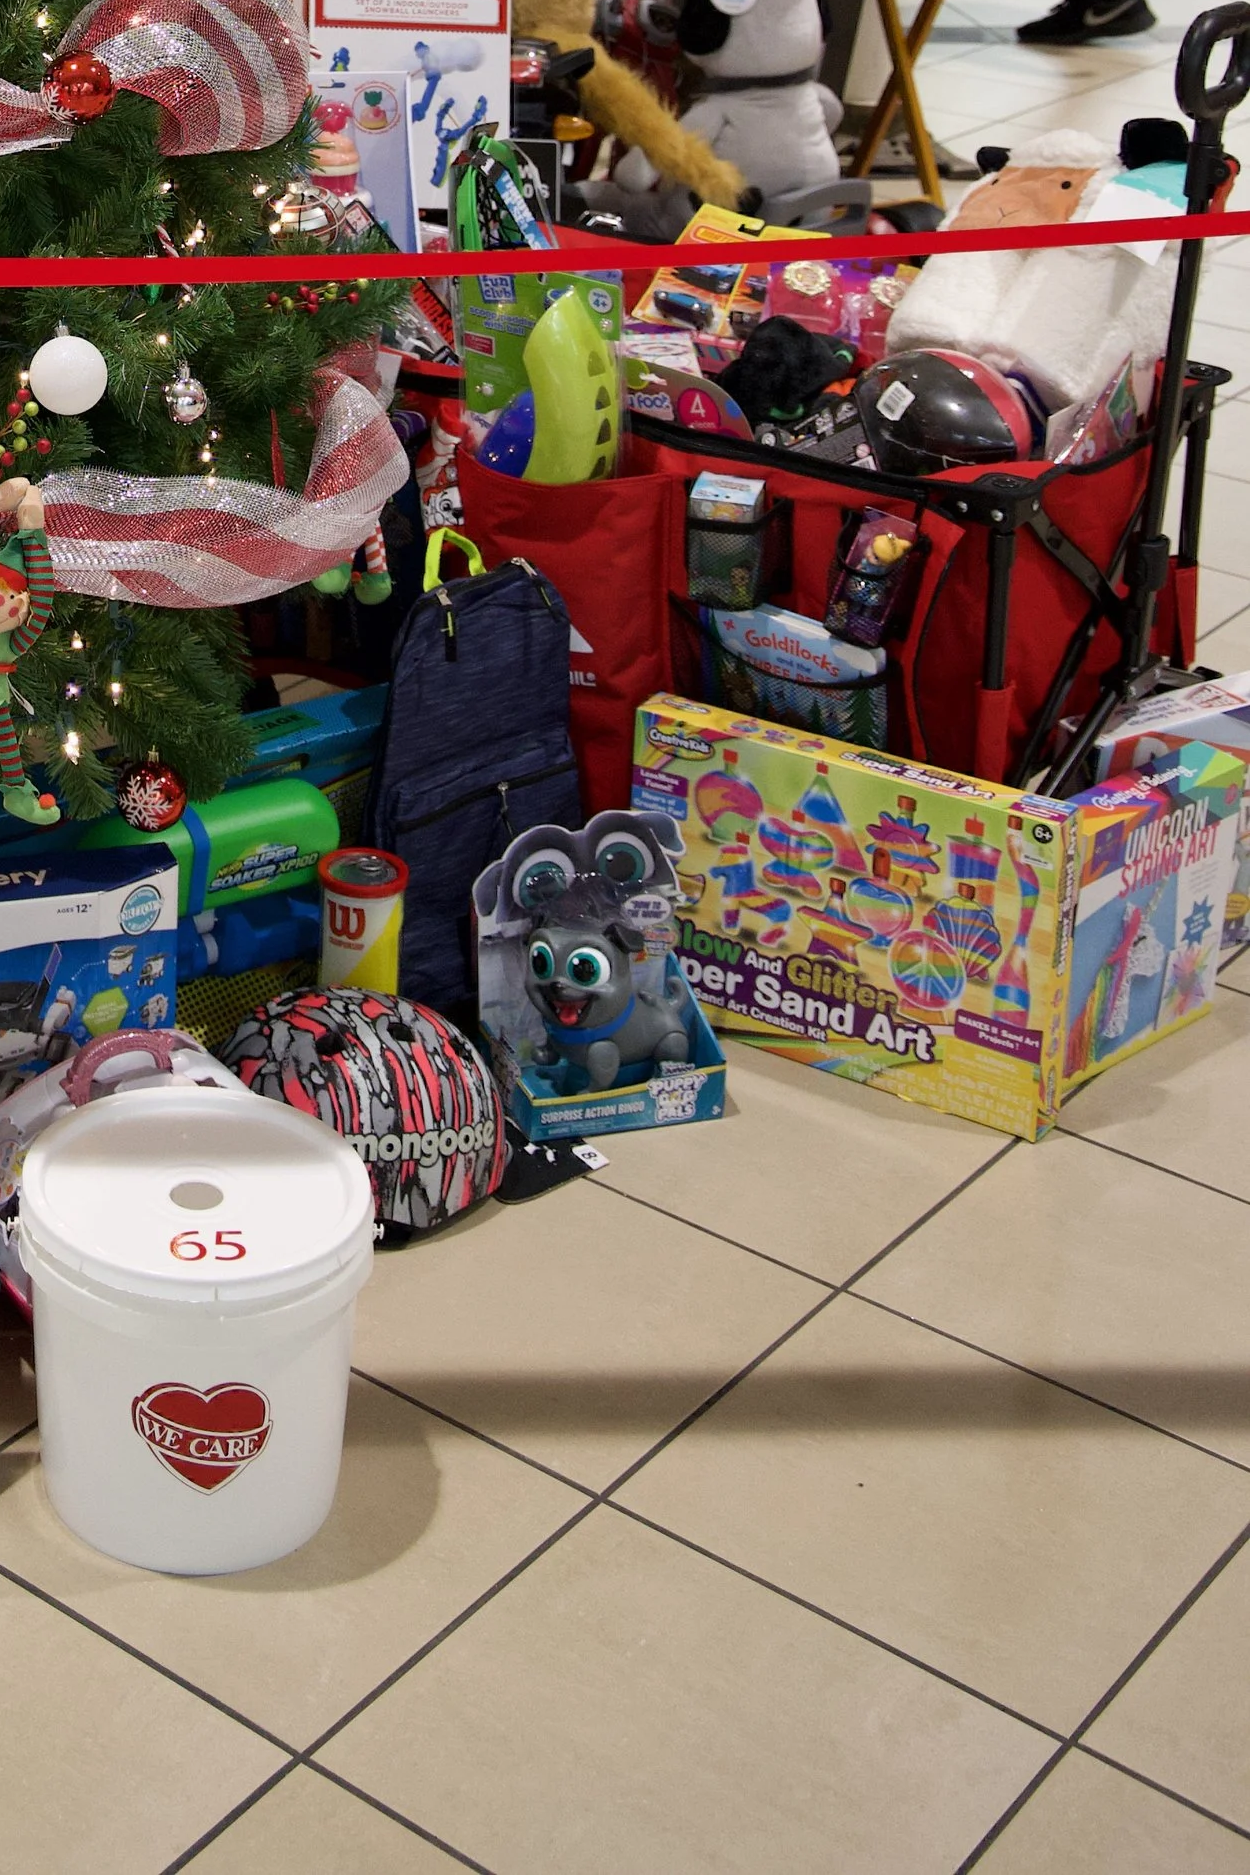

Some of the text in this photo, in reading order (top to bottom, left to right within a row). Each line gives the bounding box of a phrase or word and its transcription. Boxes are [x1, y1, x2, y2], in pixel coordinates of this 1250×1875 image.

[364, 6, 460, 16] SNOWBALL LAUNCHERS
[593, 297, 608, 308] 4+
[690, 394, 706, 417] 4
[745, 629, 841, 678] Goldilocks
[903, 768, 956, 790] Sand
[958, 784, 996, 800] Art
[1035, 827, 1053, 842] 6+
[1124, 796, 1209, 865] UNICORN
[243, 845, 298, 868] SUPER
[1118, 820, 1221, 899] STRING ART
[209, 865, 276, 892] SOAKER
[744, 950, 783, 976] And
[786, 957, 898, 1013] Glitter
[694, 988, 827, 1042] Sand Art Creation Kit
[753, 974, 855, 1034] Sand
[865, 1013, 932, 1061] Art
[648, 1074, 706, 1097] PUPPY
[657, 1091, 695, 1108] DOG
[541, 1100, 645, 1123] SURPRISE ACTION BINGO
[656, 1105, 695, 1122] PALS
[345, 1119, 495, 1167] mongoose
[169, 1230, 247, 1261] 65
[139, 1413, 259, 1459] WE CARE
